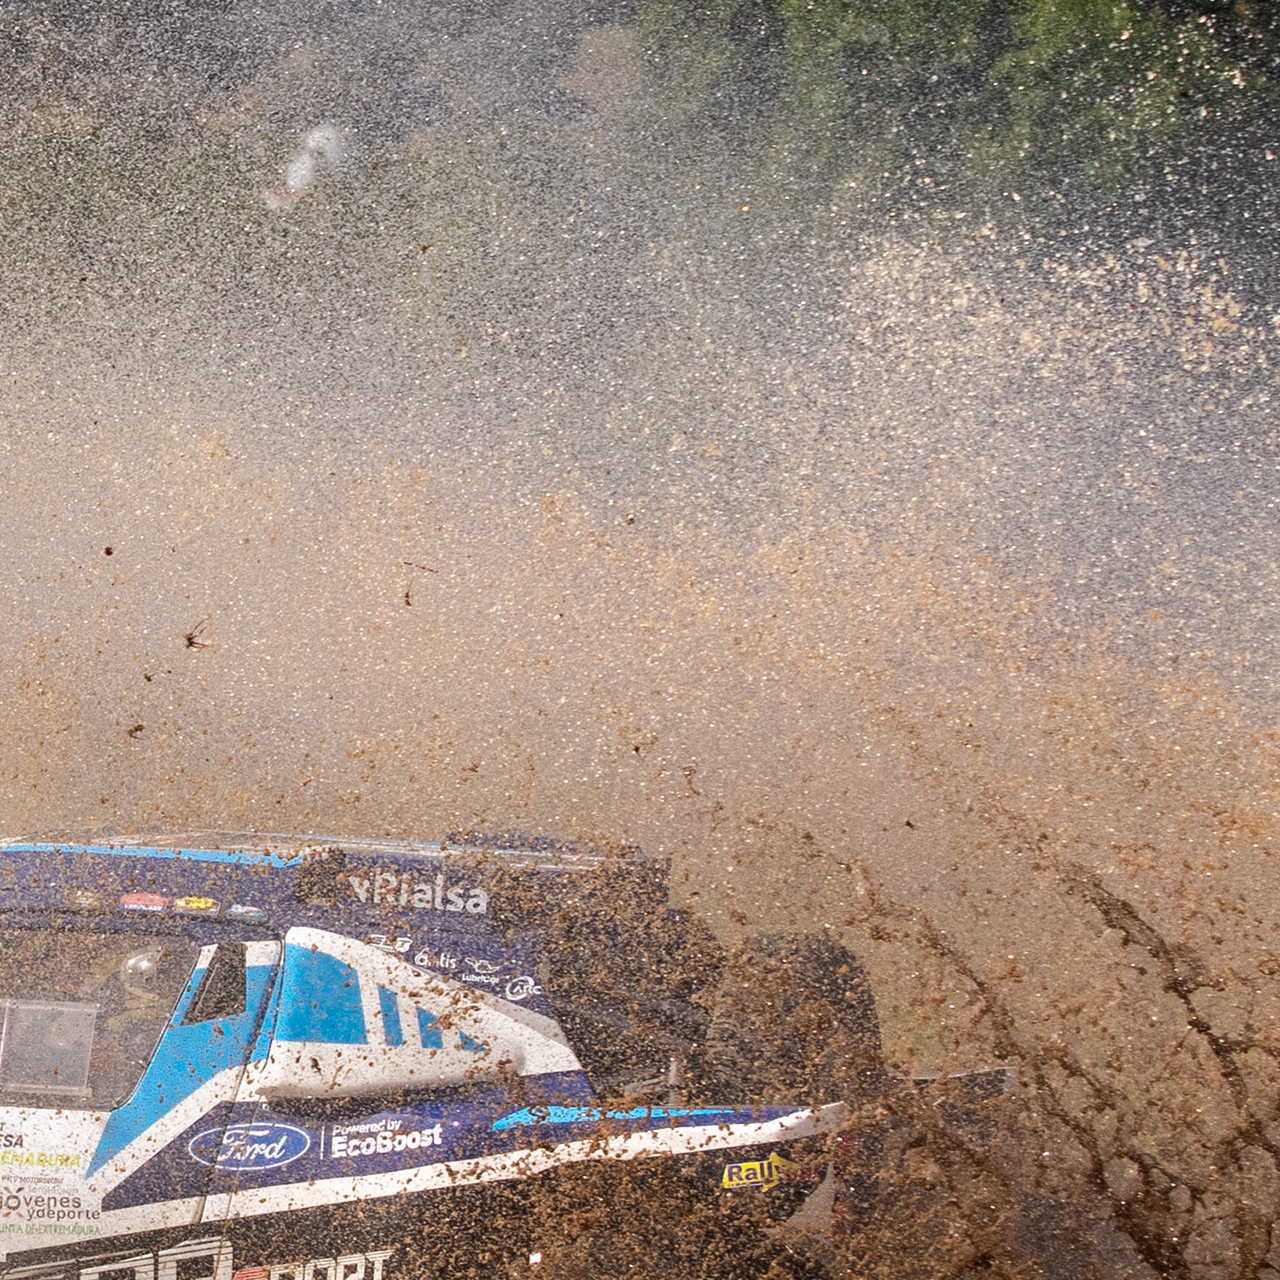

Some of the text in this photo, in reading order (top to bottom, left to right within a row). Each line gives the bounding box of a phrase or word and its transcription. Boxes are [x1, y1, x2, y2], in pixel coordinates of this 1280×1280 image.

[332, 1119, 385, 1136] Powered
[332, 1123, 443, 1158] EcoBoost
[218, 1129, 287, 1161] Ford
